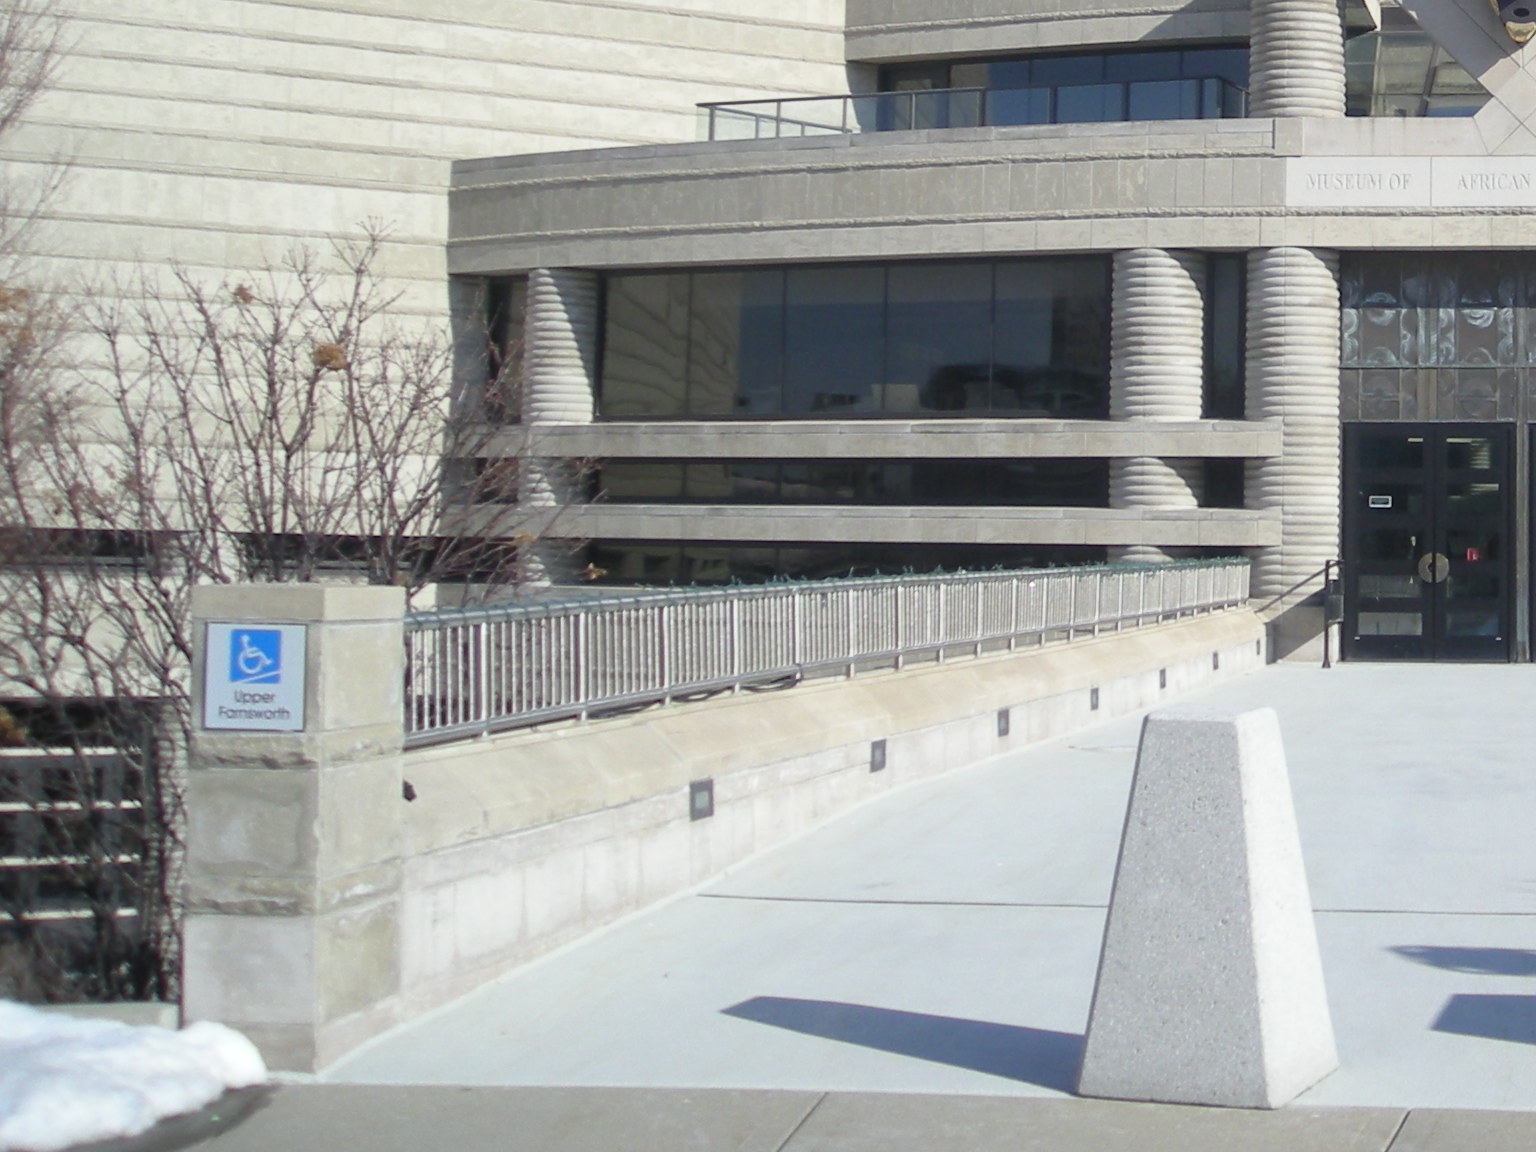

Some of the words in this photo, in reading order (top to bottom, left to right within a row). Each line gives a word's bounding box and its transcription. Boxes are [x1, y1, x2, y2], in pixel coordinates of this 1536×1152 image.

[1304, 172, 1382, 190] MUSEUM
[1388, 172, 1411, 190] OF
[1457, 172, 1531, 190] AFRICAN
[234, 689, 275, 704] Upper
